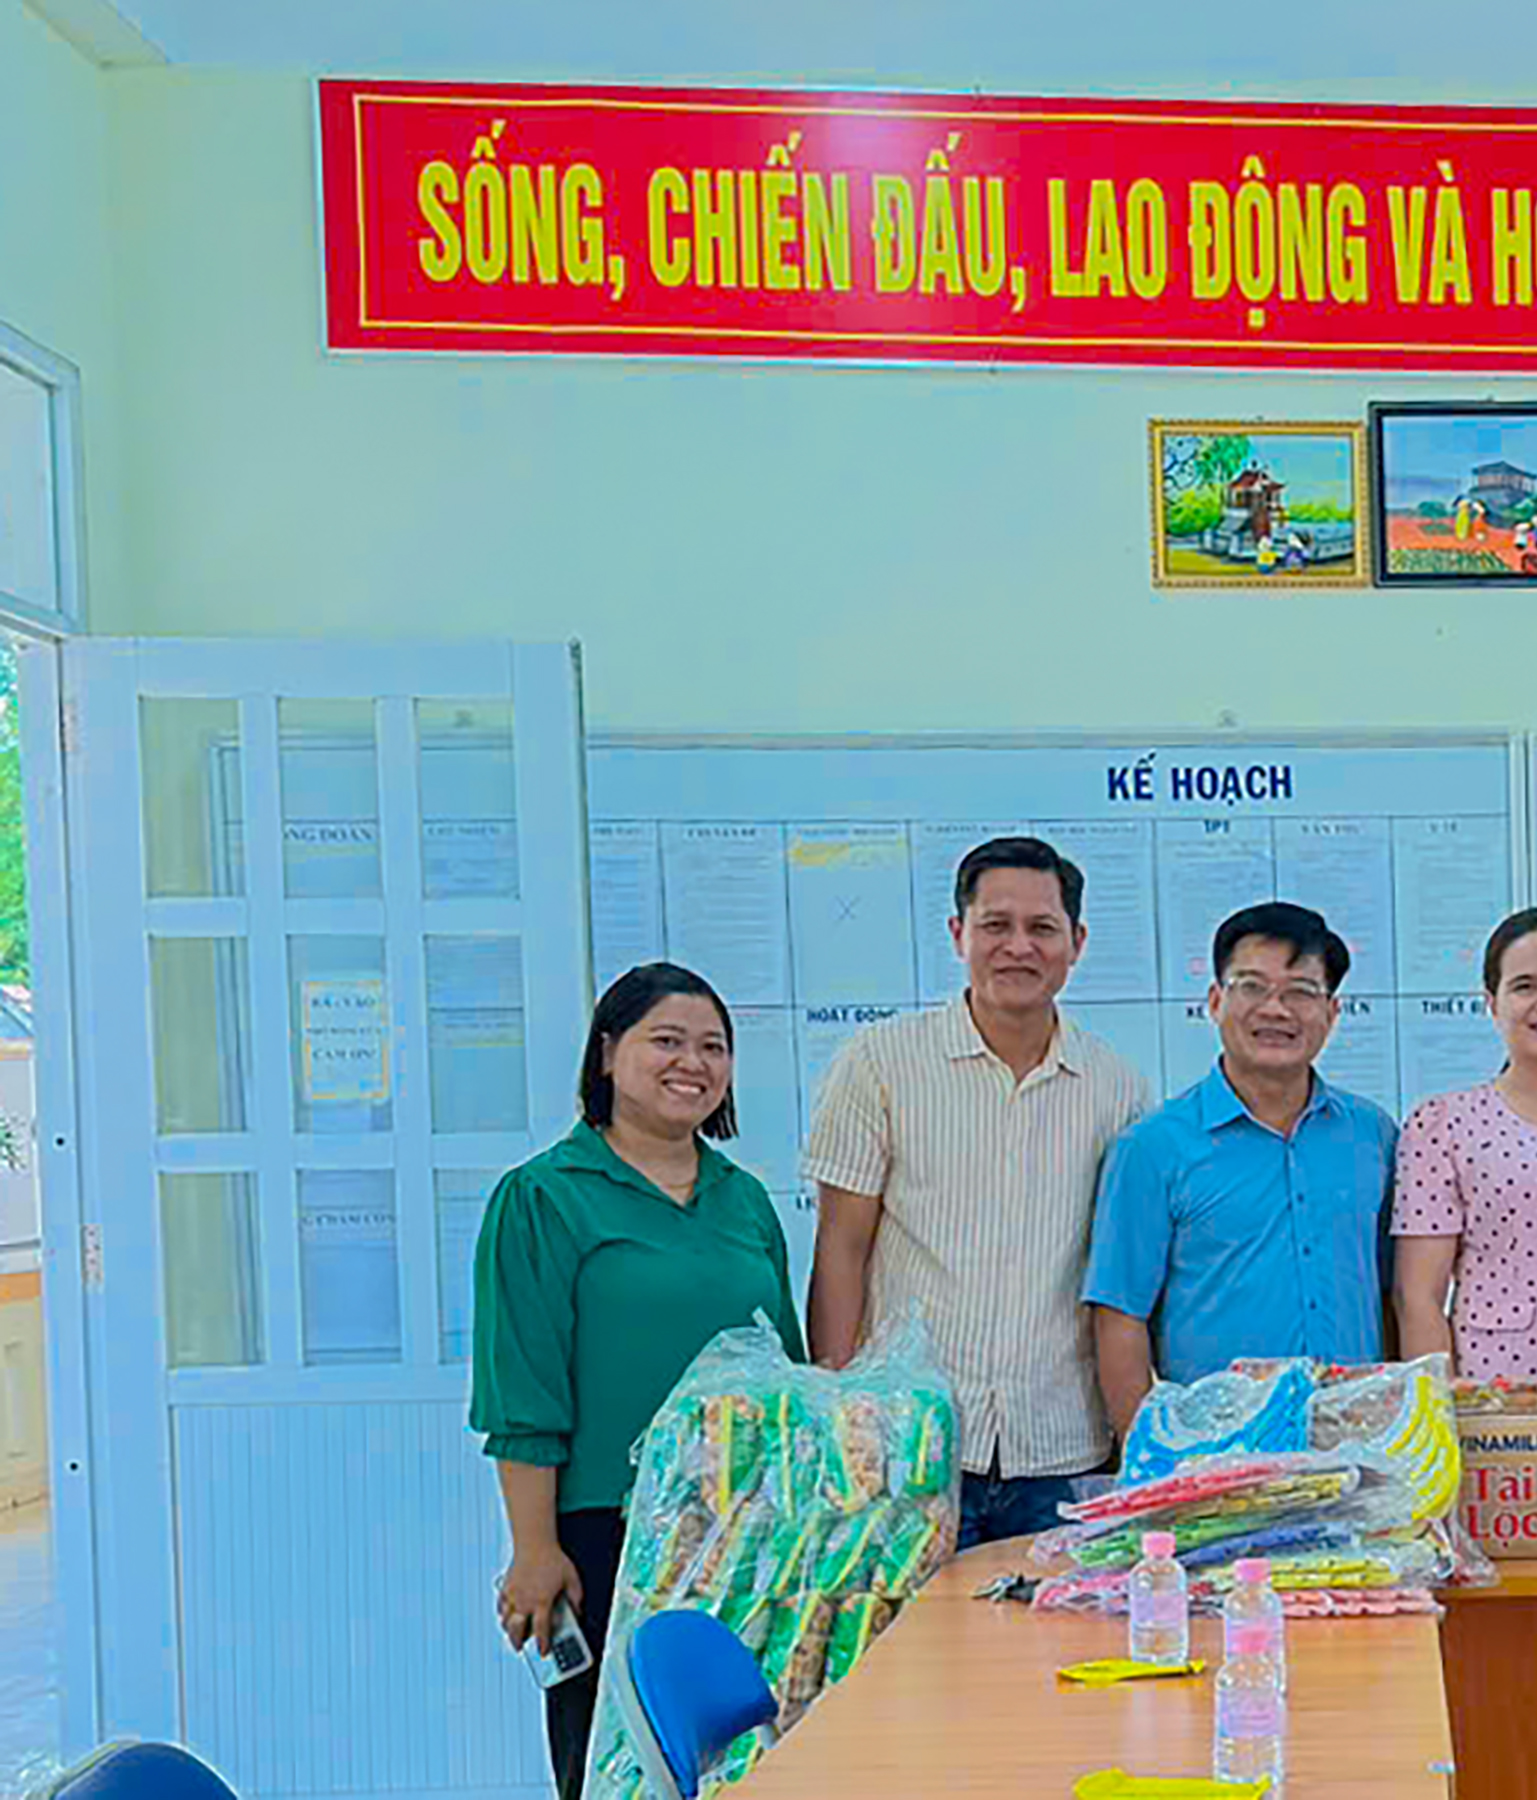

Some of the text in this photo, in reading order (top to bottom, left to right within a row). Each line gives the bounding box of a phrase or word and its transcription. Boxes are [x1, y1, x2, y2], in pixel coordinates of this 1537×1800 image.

[418, 119, 626, 301] SỐNG,
[648, 131, 852, 294] CHIẾN
[872, 132, 1028, 313] ĐẤU,
[1048, 178, 1168, 299] LAO
[1188, 156, 1369, 330] ĐỘNG
[1387, 160, 1474, 306] VÀ
[1108, 752, 1293, 806] KẾ HOẠCH
